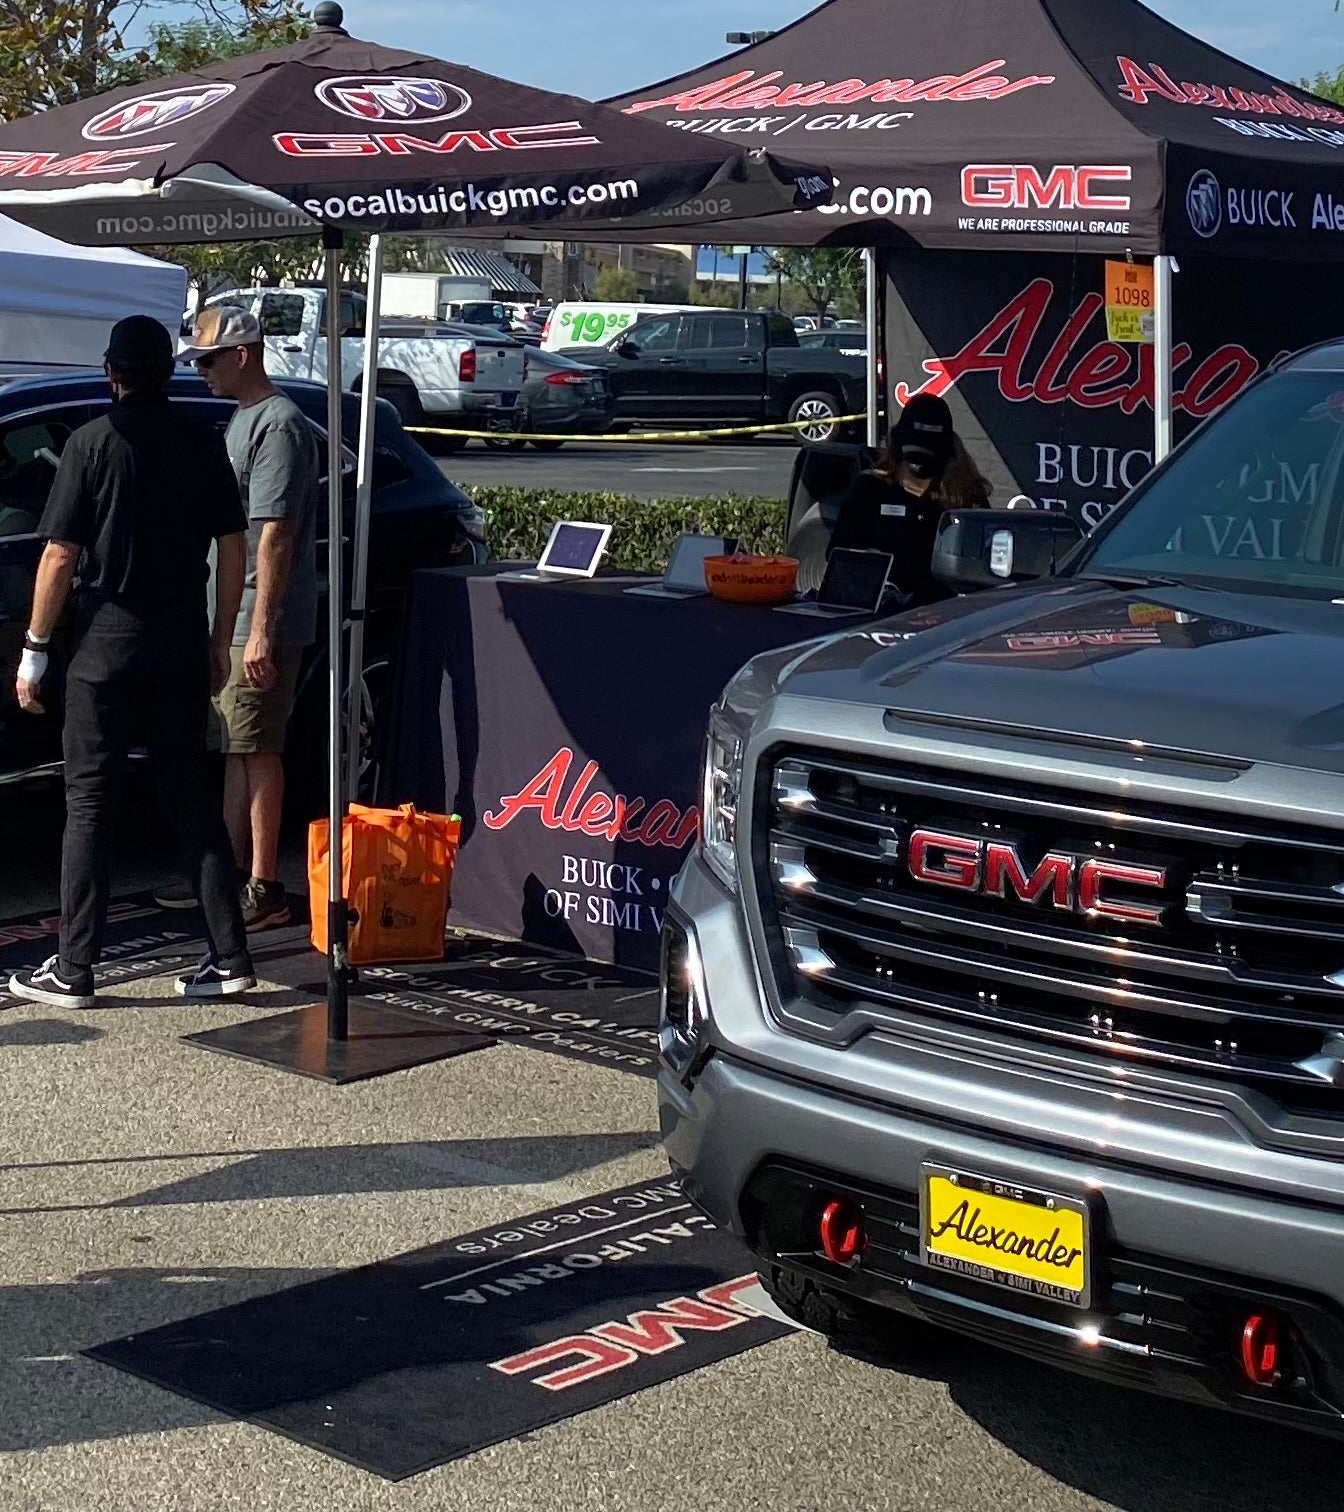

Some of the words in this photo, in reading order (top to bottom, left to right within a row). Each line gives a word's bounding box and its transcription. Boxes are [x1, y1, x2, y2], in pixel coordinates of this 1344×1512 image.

[621, 59, 1055, 115] Alexander
[271, 120, 604, 158] GMC
[805, 113, 914, 131] GMC
[304, 175, 639, 220] socalbuickgmc.com
[960, 164, 1132, 211] GMC
[1226, 188, 1297, 228] BUICK
[958, 218, 976, 230] WE
[977, 218, 999, 231] ARE
[1002, 218, 1088, 233] PROFESSIONAL
[1089, 221, 1130, 234] GRADE
[1114, 287, 1150, 307] 1098
[895, 278, 1290, 416] Alexa
[1034, 443, 1153, 490] BUIC
[561, 855, 644, 896] BUICK
[908, 829, 1165, 927] GMC
[544, 889, 580, 921] OF
[586, 896, 642, 932] SIMI
[94, 955, 183, 981] ealers
[363, 967, 550, 1015] SOUTHERN
[454, 1012, 531, 1034] GMC
[531, 1031, 653, 1066] Dealers
[454, 1205, 617, 1256] Dealers
[929, 1199, 1082, 1268] Alexander
[929, 1253, 995, 1282] ALEXANDER
[1007, 1274, 1033, 1292] SIMI
[1034, 1280, 1082, 1306] VALLEY
